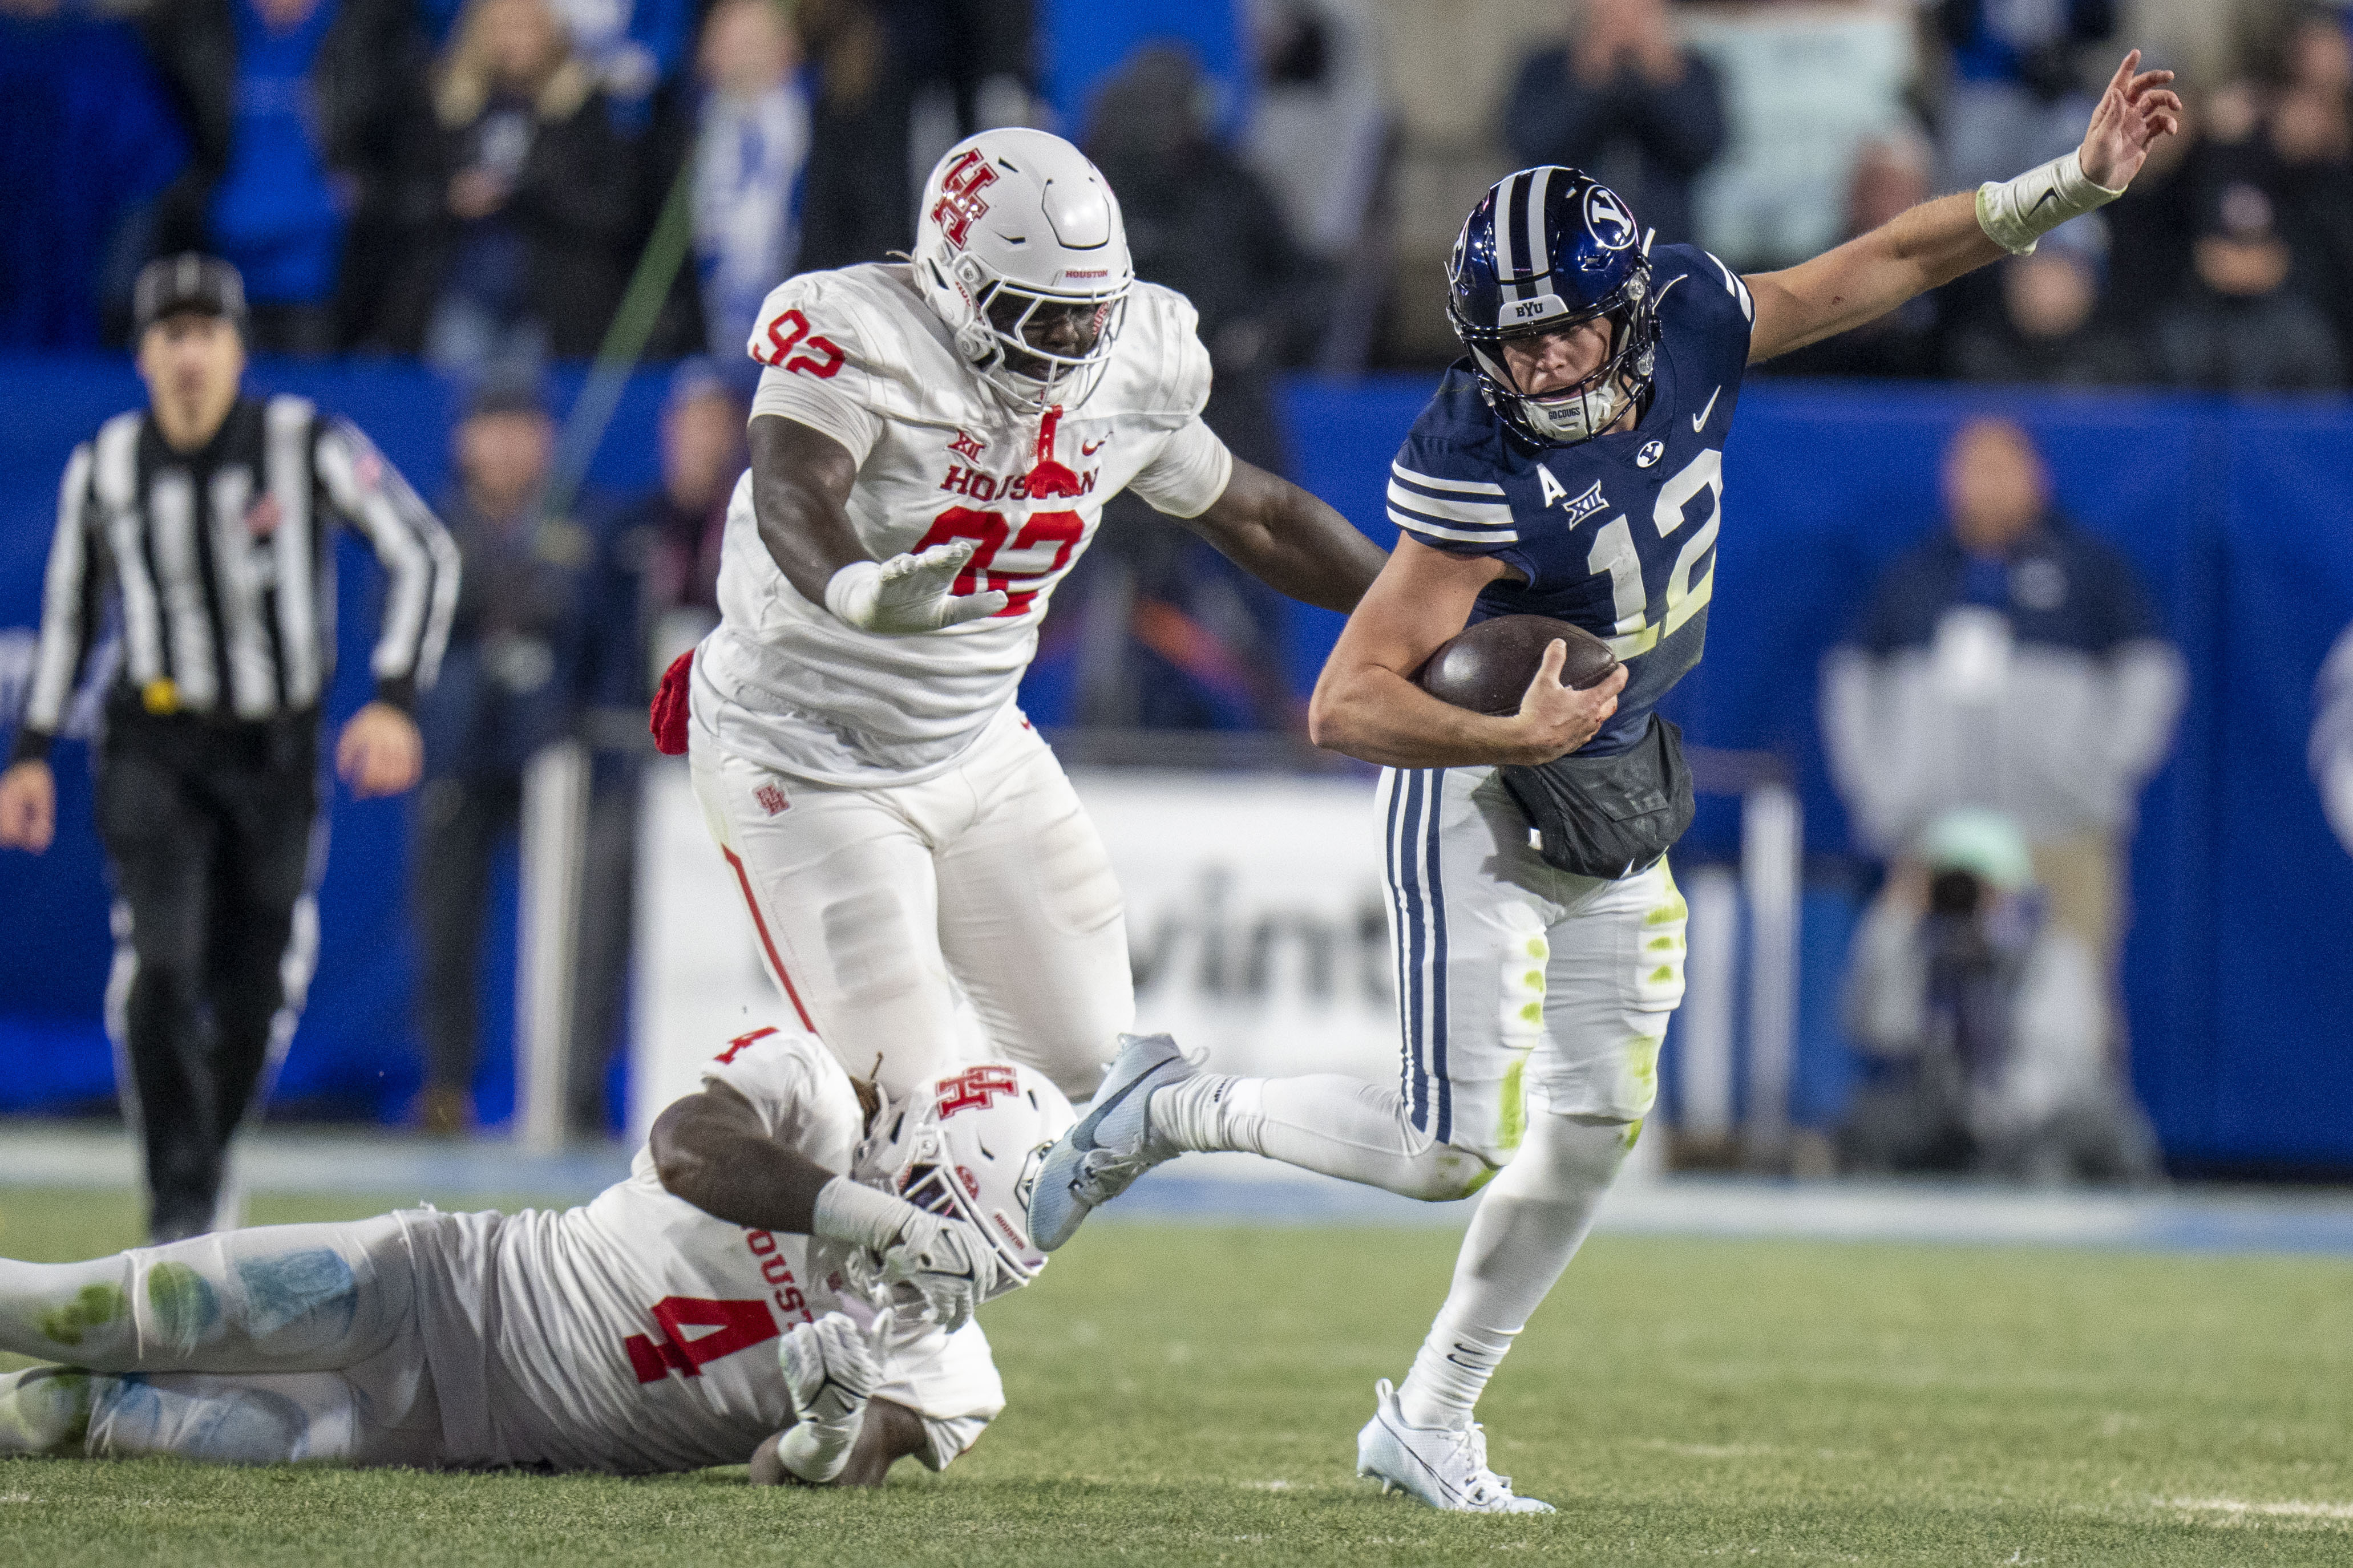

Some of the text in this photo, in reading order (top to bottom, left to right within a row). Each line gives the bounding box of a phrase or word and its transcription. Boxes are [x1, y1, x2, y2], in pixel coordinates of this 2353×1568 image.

[1592, 189, 1632, 237] Y
[1065, 270, 1109, 278] HOUSTON
[1515, 301, 1543, 317] BYU
[753, 309, 846, 379] 92
[1549, 407, 1580, 420] GO COUGS
[1639, 441, 1660, 465] Y
[1537, 463, 1567, 508] A
[1563, 480, 1609, 529] XII
[1587, 448, 1723, 662] 12
[625, 1295, 781, 1384] 4
